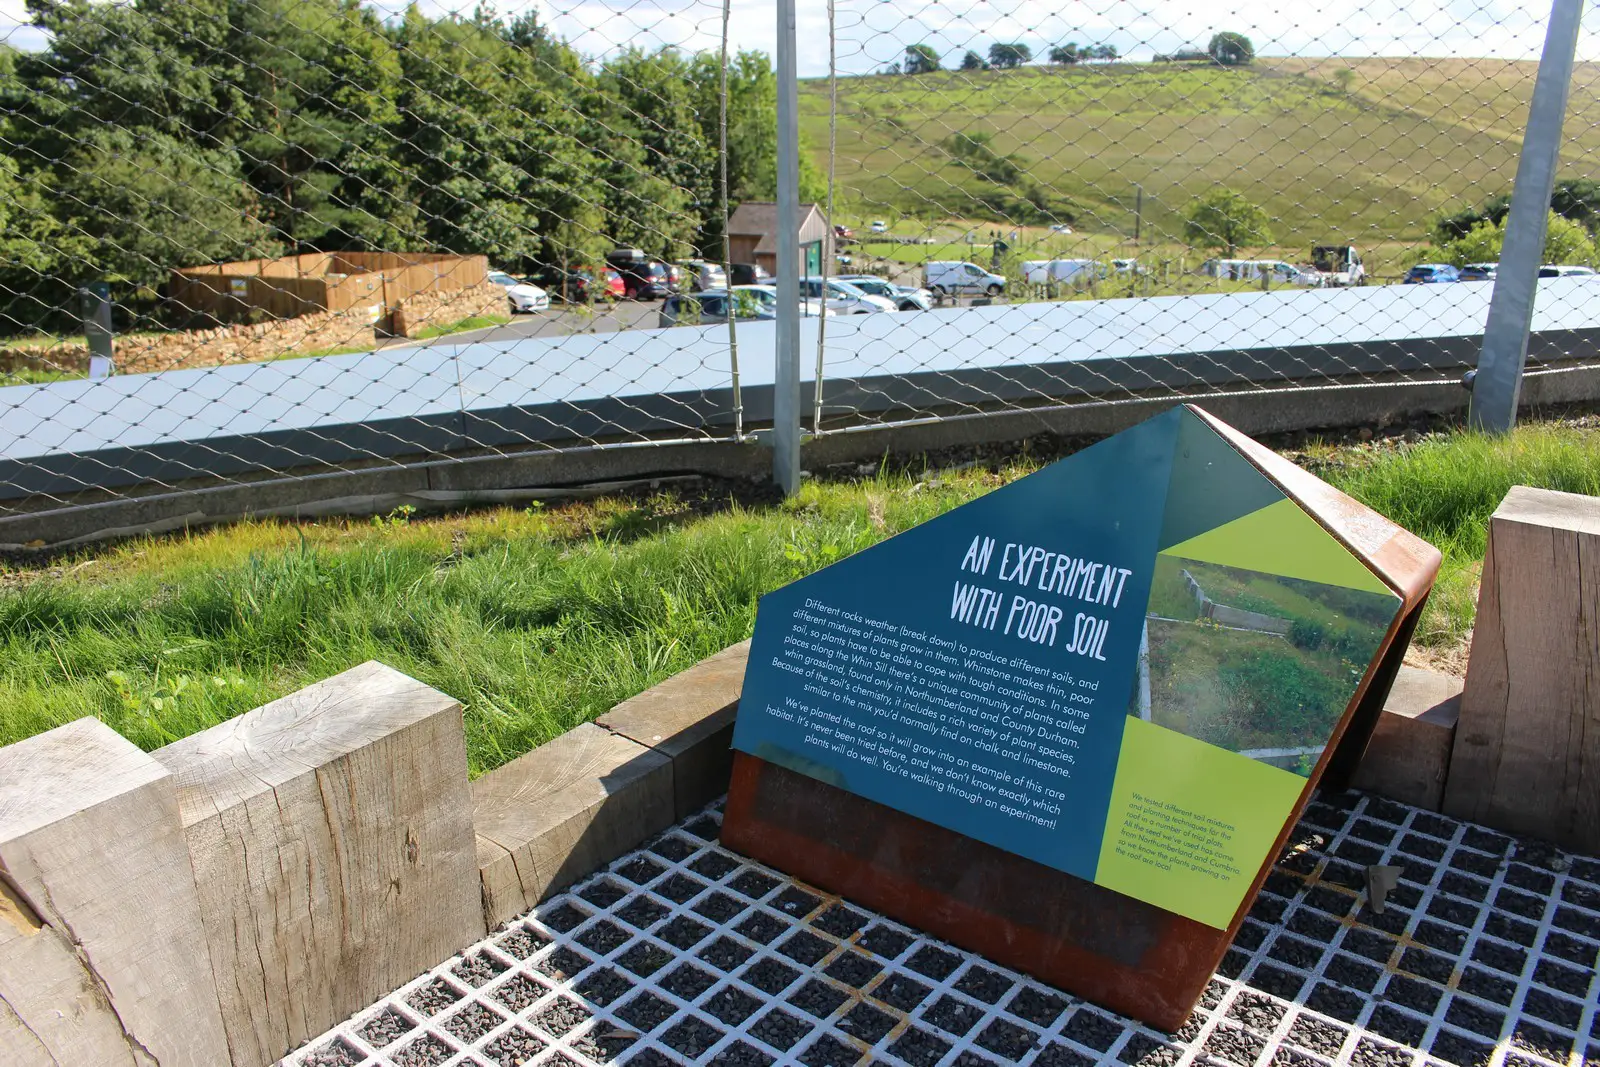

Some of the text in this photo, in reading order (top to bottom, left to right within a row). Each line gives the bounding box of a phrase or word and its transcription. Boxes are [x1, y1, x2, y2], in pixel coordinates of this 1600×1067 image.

[961, 535, 1132, 608] AN EXPERIMENT
[793, 609, 1095, 705] different mixtures of plants grow in them. Whinstone makes thin, poor
[805, 598, 1099, 691] Different rocks weather (break down) to produce different soils, and
[950, 580, 1109, 661] WITH POOR SOIL
[772, 657, 804, 675] Because
[805, 669, 815, 678] of
[816, 671, 828, 683] the
[852, 684, 892, 705] chemistry,
[895, 697, 901, 706] it
[902, 699, 938, 719] includes
[948, 715, 965, 727] rich
[968, 723, 998, 740] variety
[1000, 732, 1011, 742] of
[1011, 736, 1036, 750] plant
[1038, 746, 1075, 765] species,
[784, 634, 809, 649] places
[811, 643, 834, 658] along
[836, 650, 849, 661] the
[852, 654, 873, 668] Whin
[874, 661, 888, 672] Sill
[928, 681, 958, 695] unique
[960, 691, 1011, 713] community
[1012, 705, 1024, 715] of
[1024, 709, 1054, 725] plants
[1056, 720, 1086, 734] called
[785, 649, 1079, 749] whin grassland, found only in Northumberland and County Durham.
[792, 625, 1090, 720] soil, so plants have to be able to cope with tough conditions. In some
[766, 704, 794, 722] habitat.
[811, 723, 834, 735] never
[835, 728, 855, 743] been
[857, 737, 877, 751] tried
[878, 743, 908, 763] before,
[911, 758, 929, 769] and
[931, 765, 944, 774] we
[971, 775, 997, 792] know
[998, 788, 1031, 806] exactly
[1033, 799, 1061, 815] which
[804, 682, 831, 697] similar
[832, 692, 841, 701] to
[842, 695, 856, 706] the
[857, 702, 873, 712] mix
[900, 716, 939, 735] normally
[940, 726, 959, 740] find
[960, 736, 972, 745] on
[974, 739, 1000, 754] chalk
[1001, 749, 1021, 761] and
[1023, 753, 1071, 778] limestone.
[810, 707, 842, 724] planted
[843, 717, 856, 729] the
[857, 725, 877, 735] roof
[877, 731, 887, 739] so
[889, 732, 895, 742] it
[897, 737, 912, 748] will
[912, 744, 936, 756] grow
[938, 749, 955, 763] into
[957, 759, 969, 767] an
[972, 764, 1011, 782] example
[1013, 776, 1025, 786] of
[1026, 779, 1043, 793] this
[1045, 788, 1065, 800] rare
[804, 734, 829, 749] plants
[832, 744, 846, 754] will
[847, 748, 858, 759] do
[860, 754, 878, 767] well.
[911, 773, 945, 792] walking
[947, 783, 983, 804] through
[985, 799, 997, 809] an
[1000, 805, 1057, 830] experiment!
[1126, 812, 1141, 820] roof
[1155, 822, 1182, 834] number
[1191, 833, 1206, 842] trial
[1129, 803, 1232, 841] and planting techniques for the
[1132, 792, 1235, 832] We tested different soil mixtures
[1115, 846, 1126, 856] the
[1127, 852, 1142, 860] roof
[1142, 857, 1154, 865] are
[1120, 827, 1137, 839] from
[1138, 834, 1193, 859] Northumberland
[1193, 855, 1209, 864] and
[1123, 820, 1133, 828] All
[1134, 823, 1145, 832] the
[1145, 829, 1162, 838] seed
[1183, 841, 1200, 850] used
[1200, 845, 1213, 855] has
[1214, 852, 1234, 862] come
[1138, 844, 1156, 856] know
[1157, 851, 1168, 860] the
[1169, 856, 1190, 868] plants
[1190, 864, 1219, 879] growing
